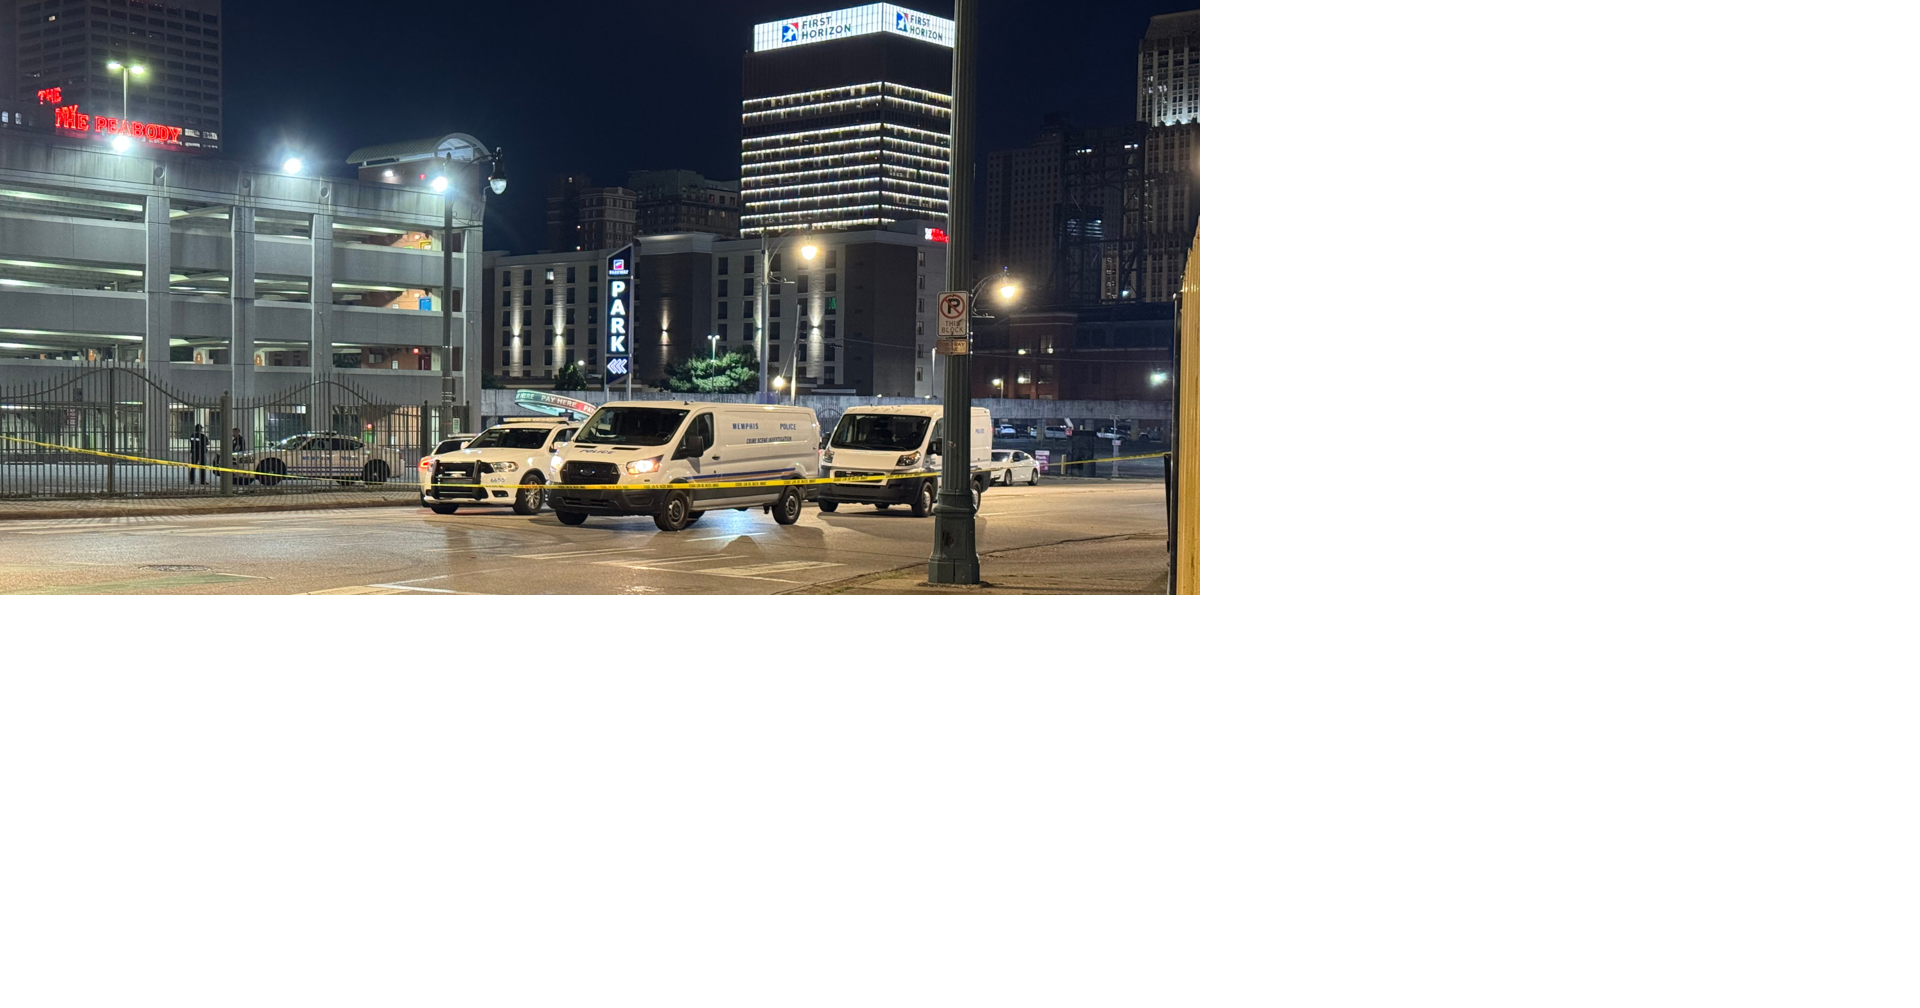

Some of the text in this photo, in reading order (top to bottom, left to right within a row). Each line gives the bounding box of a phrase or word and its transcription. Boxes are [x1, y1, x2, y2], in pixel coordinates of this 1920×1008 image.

[802, 16, 832, 29] FIRST
[910, 14, 930, 27] FIRST
[802, 24, 851, 39] HORIZON
[910, 26, 943, 41] HORIZON
[37, 87, 62, 104] THE
[94, 115, 182, 143] PEABODY
[610, 281, 626, 352] PARK
[541, 395, 577, 407] PAY HERE
[732, 422, 759, 430] MEMPHIS
[779, 423, 797, 431] POLICE
